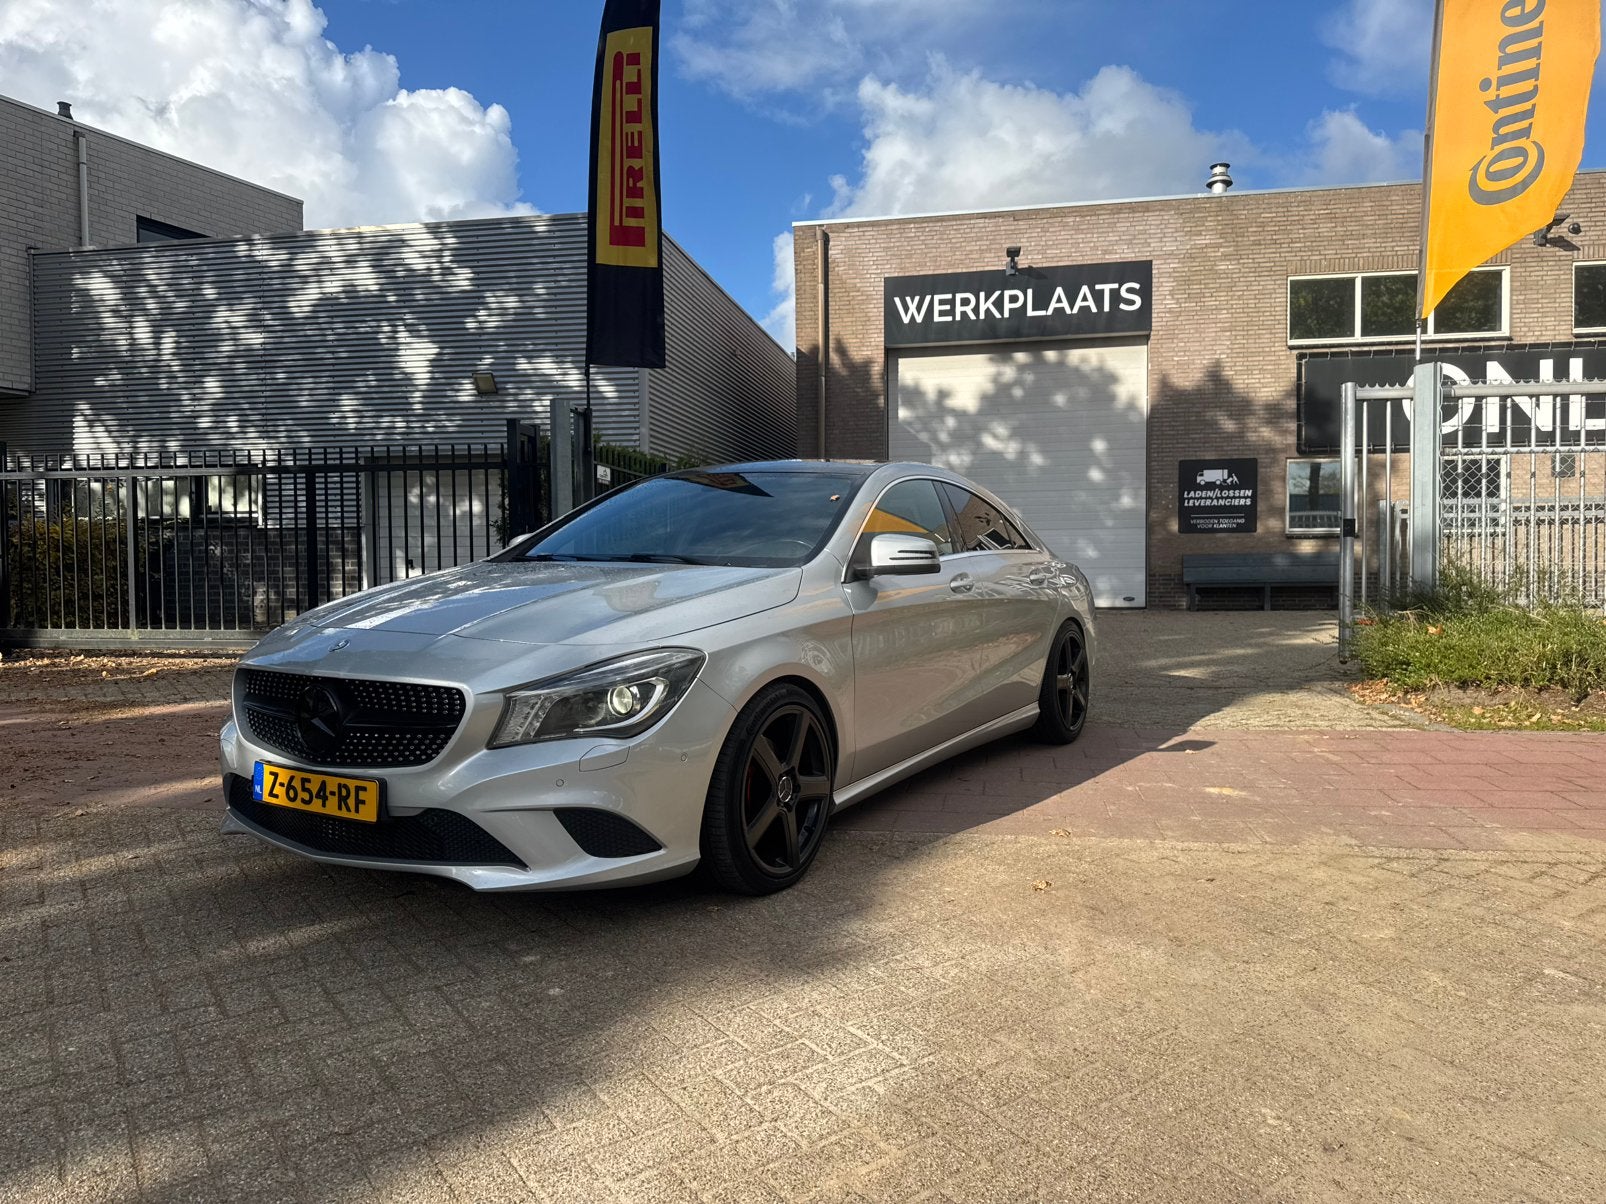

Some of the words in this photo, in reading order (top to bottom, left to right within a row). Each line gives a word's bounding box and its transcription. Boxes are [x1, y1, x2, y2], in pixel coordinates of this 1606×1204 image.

[1468, 0, 1546, 206] Contine
[609, 51, 645, 247] PIRELLI
[893, 281, 1142, 324] WERKPLAATS
[1184, 488, 1253, 498] LADEN/LOSSEN
[1184, 498, 1252, 506] LEVERANCIERS
[254, 784, 262, 794] NL
[268, 771, 368, 814] Z-654-RF
